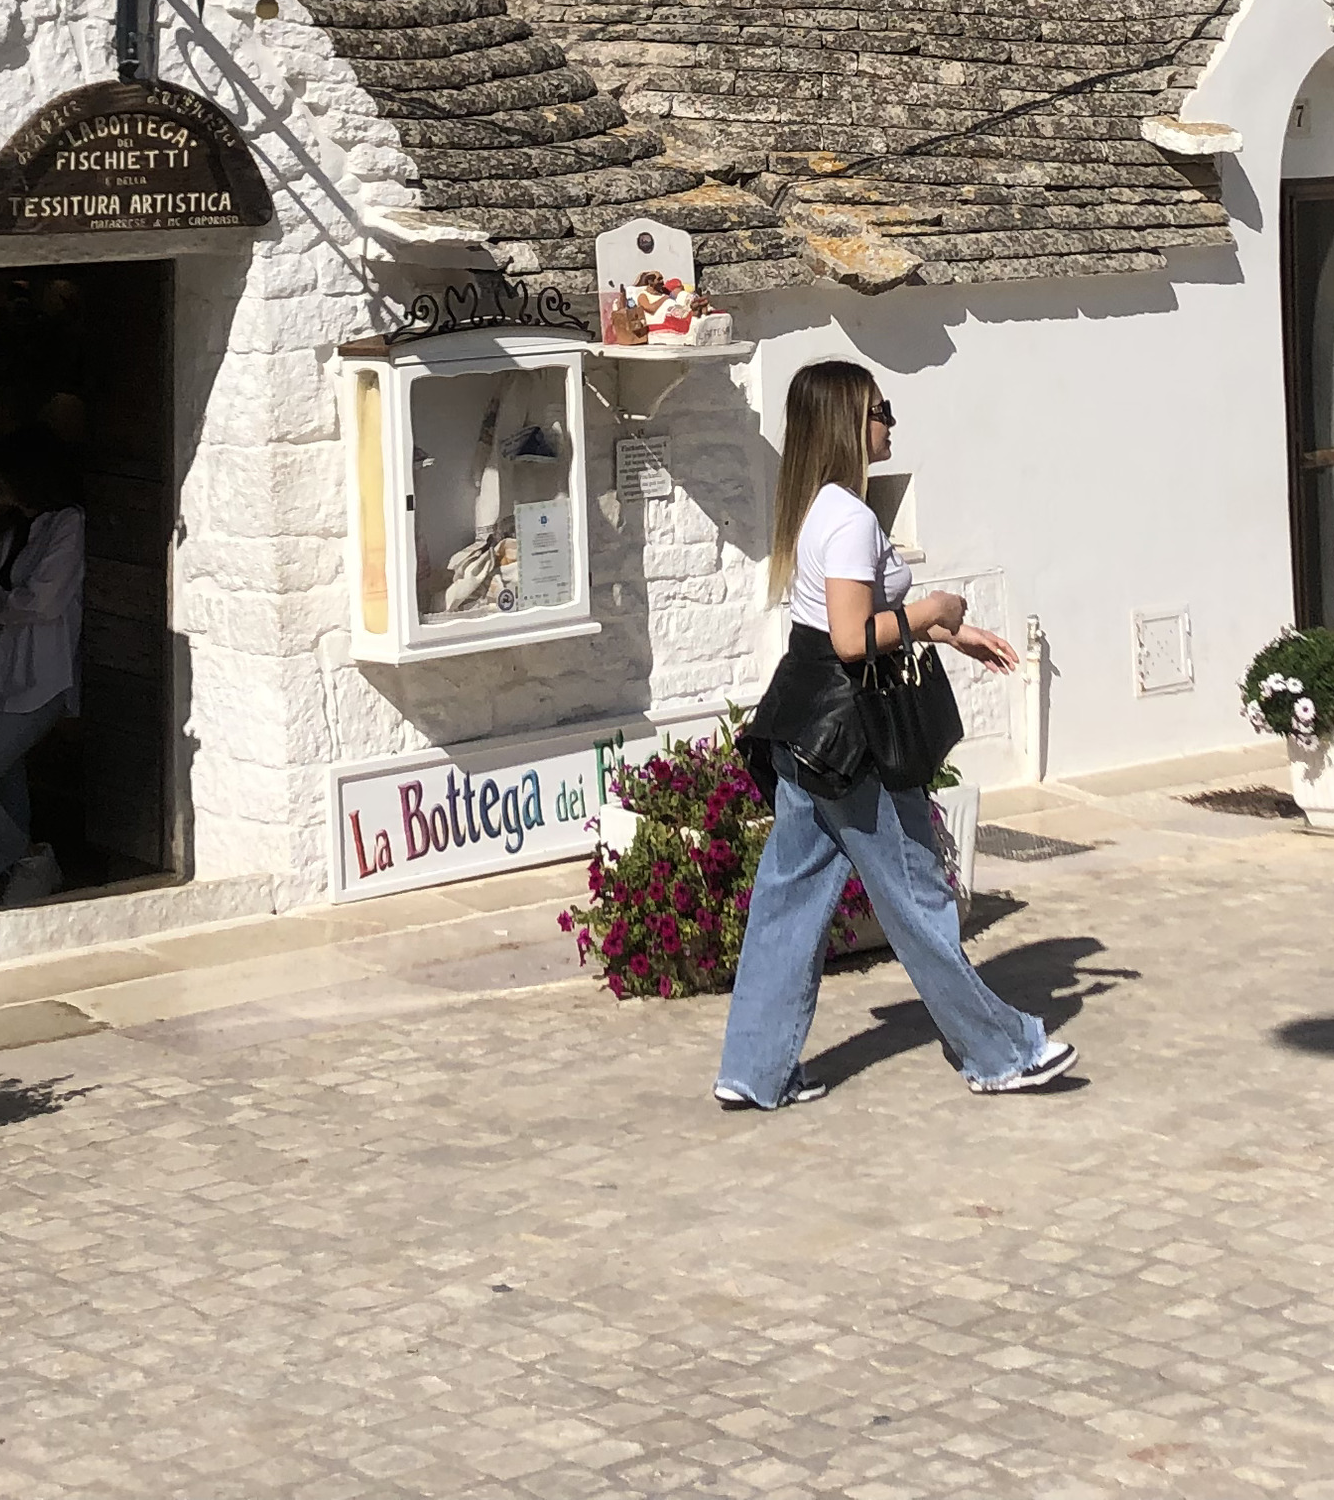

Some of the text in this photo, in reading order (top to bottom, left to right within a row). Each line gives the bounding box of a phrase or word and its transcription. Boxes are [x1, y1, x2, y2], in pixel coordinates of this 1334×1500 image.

[1296, 104, 1304, 128] 7
[95, 114, 188, 148] BOTTEGA
[117, 138, 134, 148] DEI
[56, 149, 189, 171] FISCHIETTI
[117, 176, 147, 186] DELLA
[7, 192, 232, 217] TESSITURA ARTISTICA
[349, 767, 587, 879] La Bottega dei
